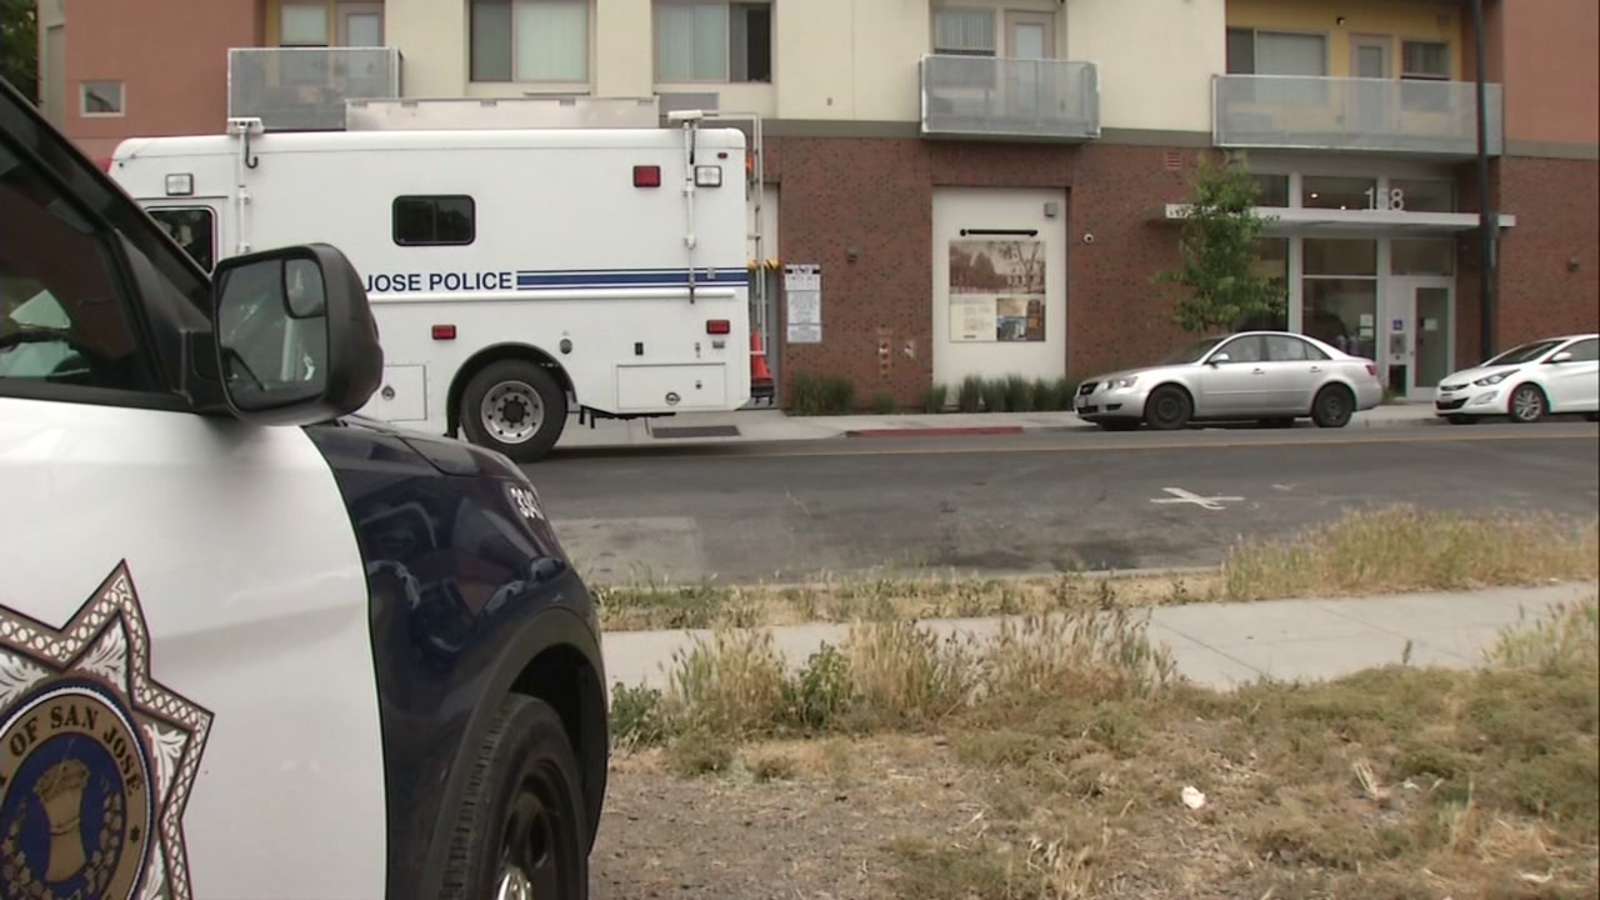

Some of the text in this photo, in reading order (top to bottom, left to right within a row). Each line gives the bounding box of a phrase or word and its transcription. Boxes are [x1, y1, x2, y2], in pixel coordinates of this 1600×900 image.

[1365, 187, 1404, 210] 158
[366, 271, 513, 292] JOSE POLICE
[9, 704, 141, 797] OF SAN JOSE
